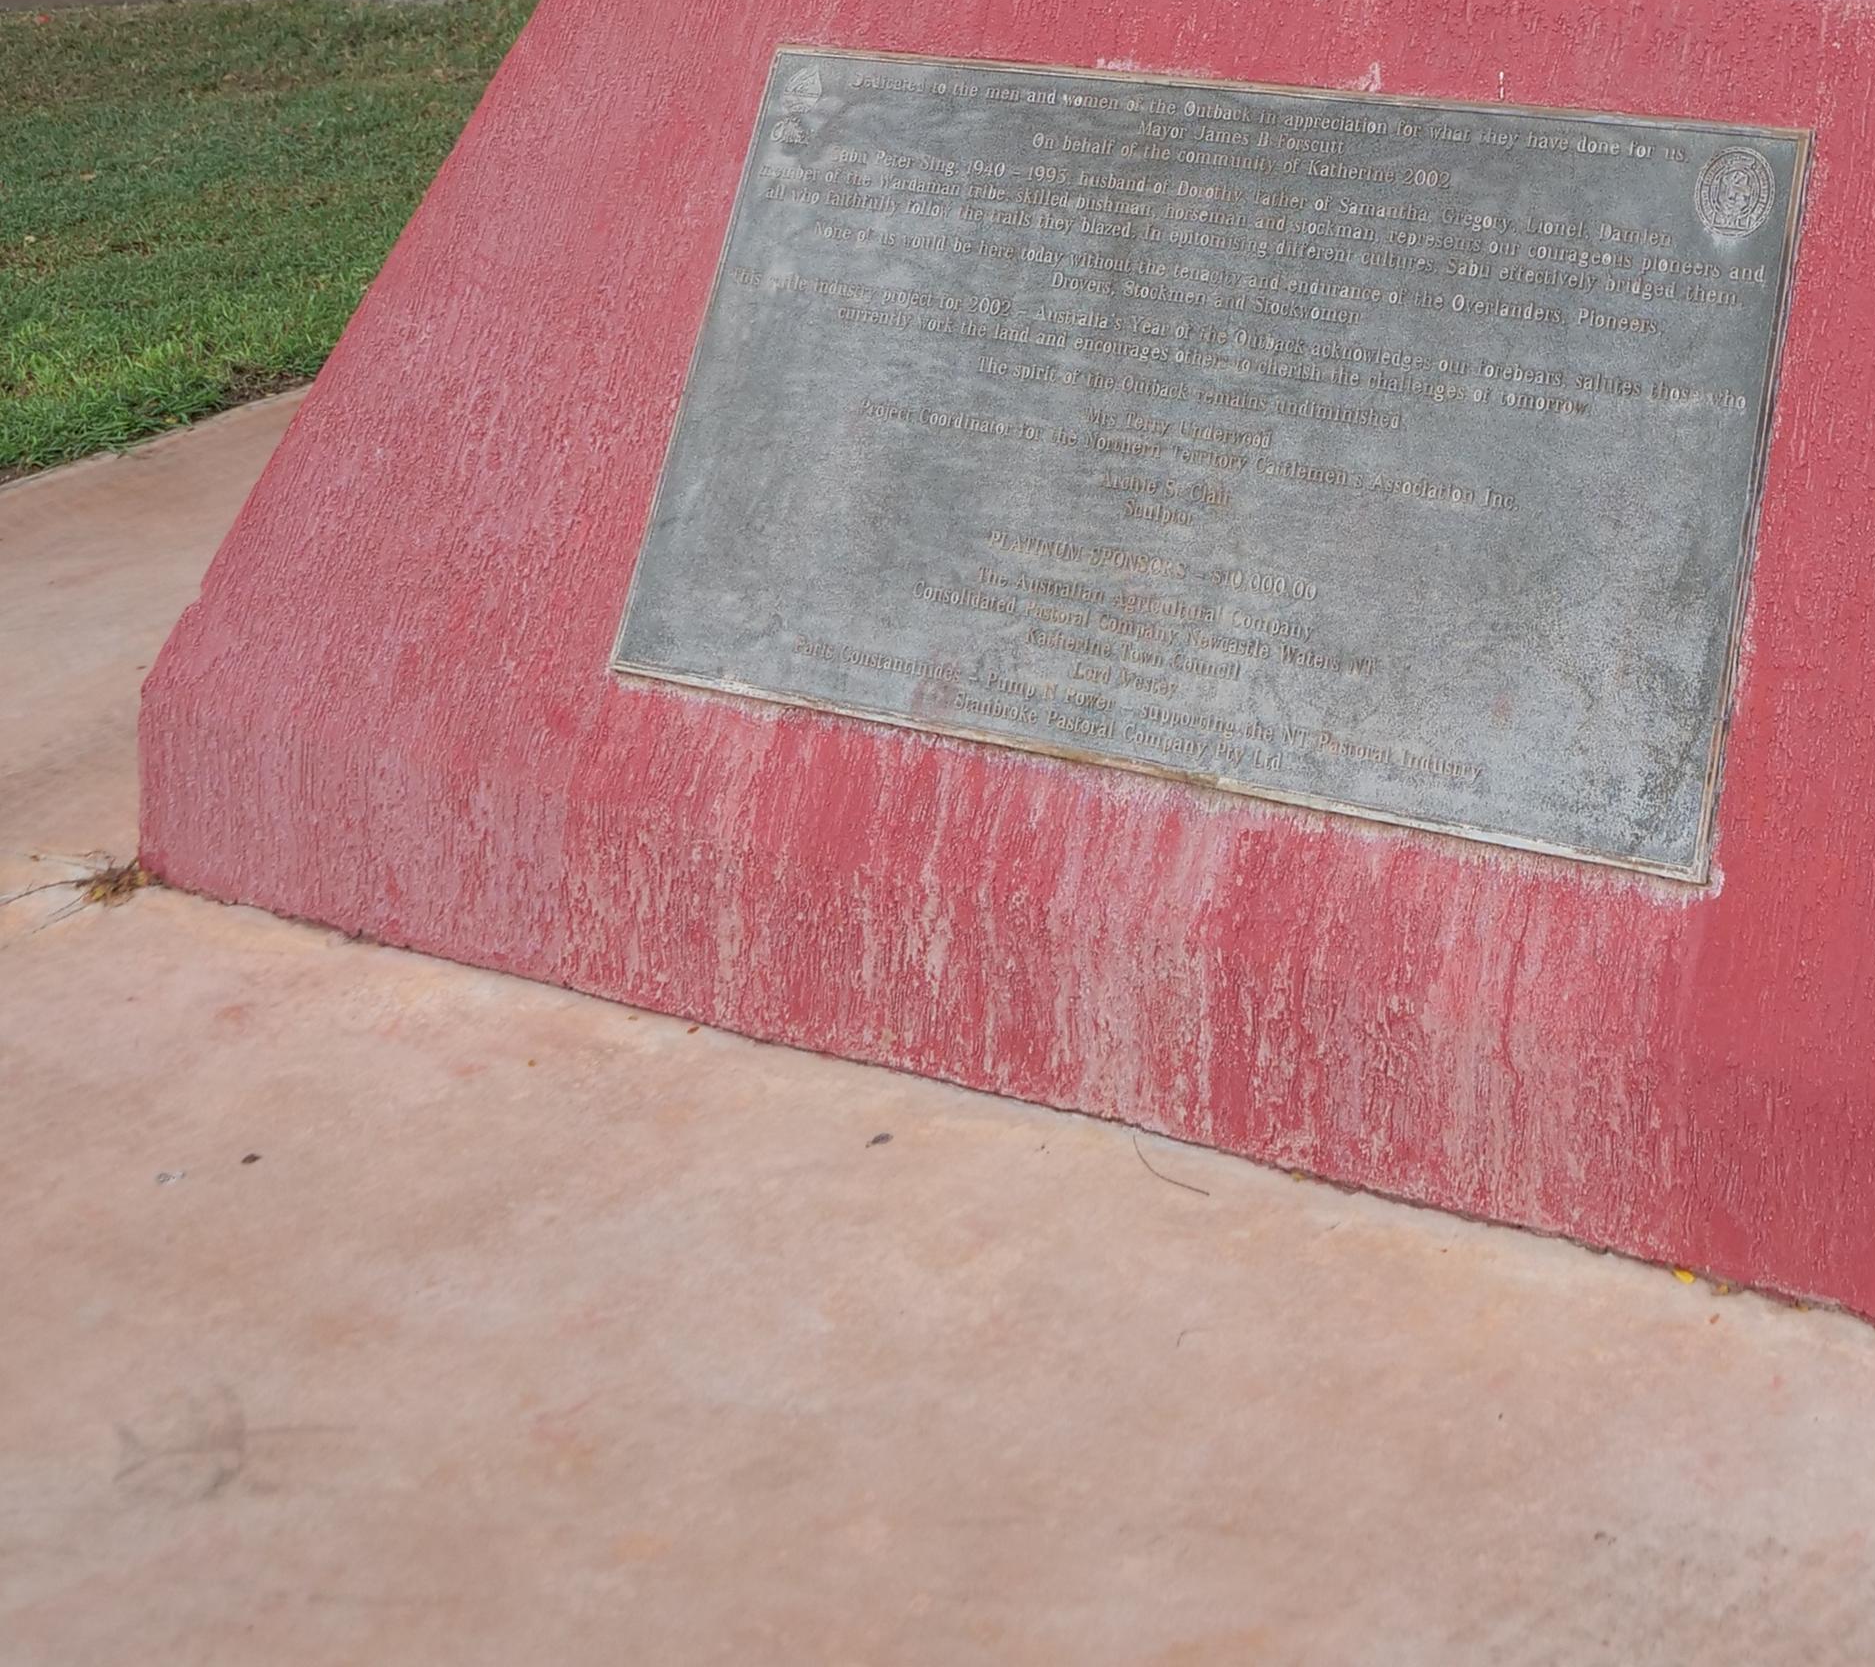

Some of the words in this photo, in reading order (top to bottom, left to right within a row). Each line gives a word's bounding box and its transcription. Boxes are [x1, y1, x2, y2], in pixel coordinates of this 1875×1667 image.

[931, 79, 948, 95] to
[951, 81, 980, 98] the
[984, 87, 1021, 102] men
[1025, 87, 1058, 105] and
[1061, 94, 1119, 111] women
[1124, 96, 1144, 113] of
[1147, 98, 1179, 116] the
[1182, 101, 1253, 123] Outback
[1258, 108, 1280, 125] in
[1281, 110, 1388, 139] appreciation
[1394, 120, 1423, 138] for
[1427, 123, 1472, 143] what
[1476, 127, 1521, 151] they
[1525, 131, 1570, 152] have
[1575, 136, 1622, 156] done
[1627, 140, 1656, 159] for
[1136, 120, 1187, 144] Mayor
[1192, 125, 1251, 146] James
[829, 145, 870, 164] Sabu
[873, 149, 915, 169] Peter
[965, 158, 1007, 179] 1940
[1077, 170, 1147, 193] husband
[1152, 177, 1171, 196] of
[1253, 187, 1309, 210] father
[1313, 193, 1333, 212] of
[1030, 132, 1056, 149] On
[1061, 135, 1116, 155] behalf
[1119, 140, 1139, 158] of
[1142, 142, 1172, 161] the
[1174, 146, 1276, 175] community
[1281, 156, 1301, 174] of
[1402, 168, 1451, 189] 2002
[764, 183, 786, 200] all
[789, 185, 822, 204] who
[904, 198, 951, 218] follow
[955, 203, 985, 222] the
[988, 207, 1033, 228] trails
[1034, 212, 1075, 236] they
[1274, 238, 1354, 263] different
[1445, 257, 1492, 279] Sabu
[1497, 262, 1599, 294] effectively
[1602, 274, 1678, 303] bridged
[823, 167, 842, 185] of
[876, 173, 962, 198] Wardaman
[1014, 187, 1070, 209] skilled
[1162, 202, 1248, 228] horseman
[1254, 212, 1287, 232] and
[1387, 225, 1483, 257] represents
[1487, 240, 1520, 257] our
[1526, 244, 1633, 273] courageous
[1640, 251, 1722, 282] pioneers
[1728, 260, 1766, 283] and
[811, 220, 853, 241] None
[901, 231, 947, 252] would
[951, 236, 974, 255] be
[977, 239, 1015, 260] here
[1018, 244, 1065, 269] today
[1068, 250, 1133, 273] without
[1136, 257, 1167, 277] the
[1246, 270, 1281, 291] and
[1287, 274, 1383, 303] endurance
[1387, 286, 1407, 305] of
[1412, 289, 1446, 310] the
[1122, 279, 1208, 306] Stockmen
[1213, 290, 1246, 310] and
[1253, 294, 1362, 324] Stockwomen
[835, 303, 913, 332] currently
[917, 313, 956, 334] work
[959, 319, 988, 338] the
[992, 323, 1030, 343] land
[1034, 328, 1068, 349] and
[1072, 337, 1169, 366] encourages
[1257, 357, 1325, 382] cherish
[1329, 366, 1362, 387] the
[1366, 371, 1466, 405] challenges
[1471, 384, 1491, 404] of
[880, 285, 935, 311] project
[937, 292, 963, 311] for
[966, 295, 1012, 317] 2002
[1031, 303, 1124, 331] Australia's
[1130, 315, 1169, 337] Year
[1174, 321, 1194, 340] of
[1199, 324, 1229, 344] the
[1233, 328, 1306, 354] Outback
[1310, 337, 1434, 374] acknowledges
[1438, 357, 1470, 374] our
[1574, 369, 1643, 396] salutes
[1705, 386, 1747, 409] who
[975, 355, 1010, 376] The
[1010, 360, 1059, 386] spirit
[1061, 367, 1081, 386] of
[1085, 370, 1116, 391] the
[1120, 374, 1189, 401] Outback
[1196, 384, 1268, 411] remains
[917, 407, 1013, 437] Coordinator
[1370, 472, 1476, 505] Association
[1121, 410, 1173, 439] Terry
[986, 529, 1084, 563] PLATINUM
[910, 579, 1017, 615] Consolidated
[1096, 612, 1179, 648] Company
[1184, 627, 1271, 660] Newcastle
[1278, 643, 1343, 673] Waters
[975, 565, 1010, 587] The
[1014, 572, 1106, 604] Australian
[1110, 588, 1222, 628] Agricultural
[1228, 609, 1315, 645] Company
[1025, 625, 1113, 658] Katherine
[1117, 642, 1165, 668] Town
[1169, 651, 1241, 681] Council
[1071, 660, 1113, 685] Lord
[953, 690, 1040, 724] Stanbroke
[1046, 708, 1117, 739] Pastoral
[1120, 723, 1208, 761] Company
[984, 671, 1037, 702] Pump
[1063, 685, 1118, 713] Power
[1281, 726, 1310, 749] NT
